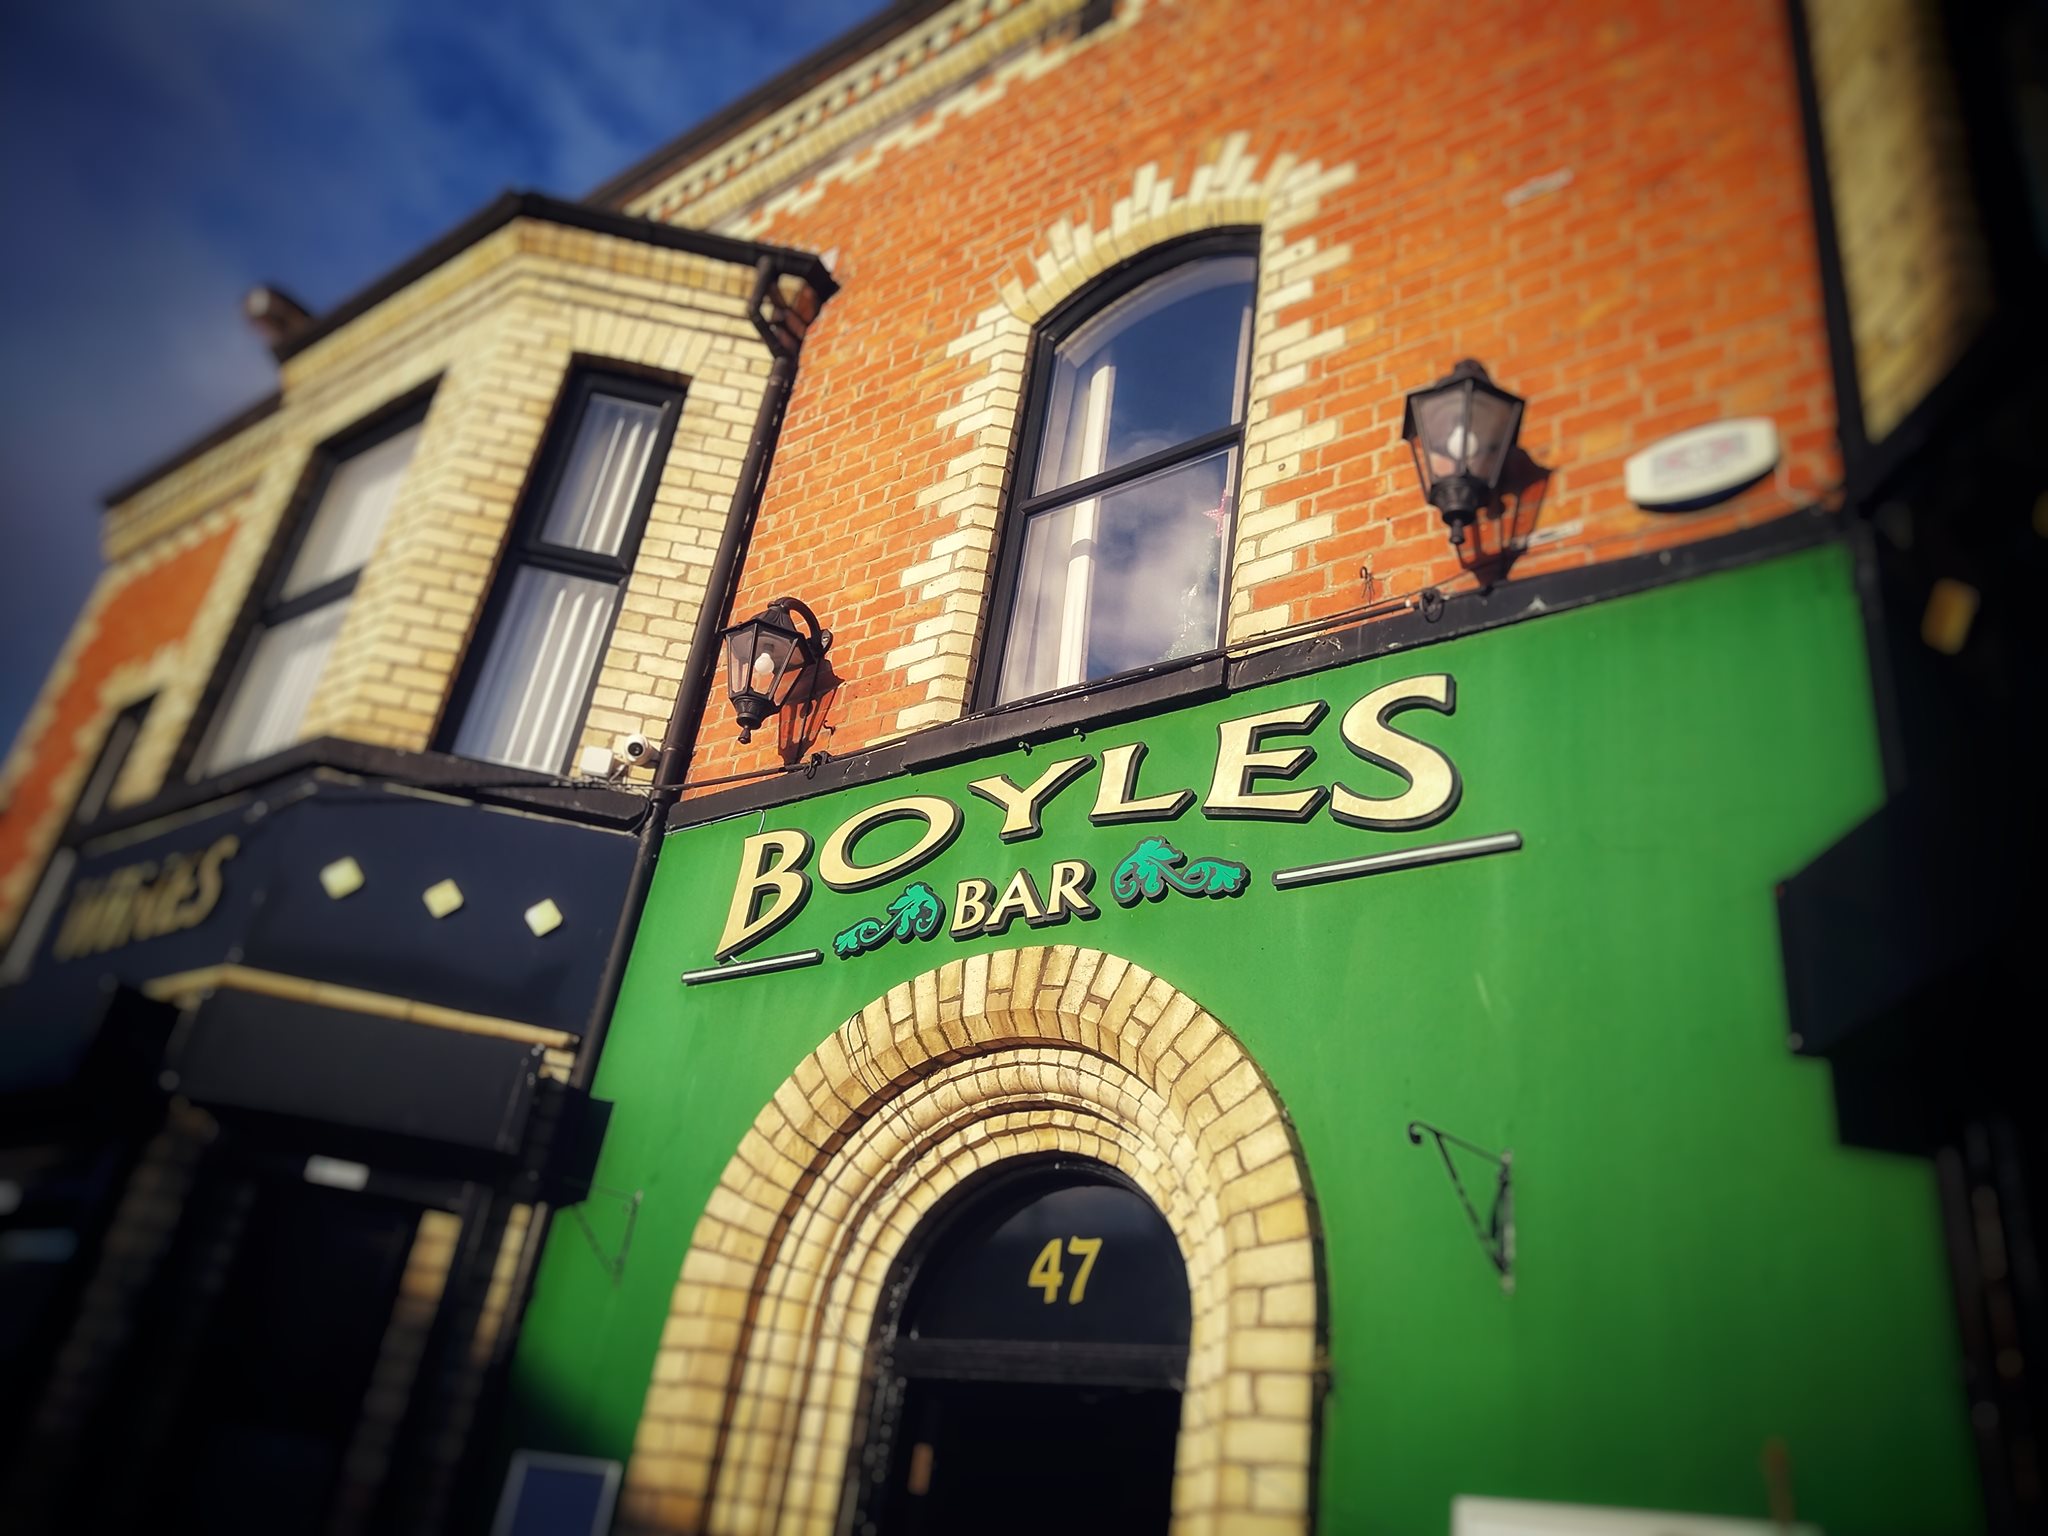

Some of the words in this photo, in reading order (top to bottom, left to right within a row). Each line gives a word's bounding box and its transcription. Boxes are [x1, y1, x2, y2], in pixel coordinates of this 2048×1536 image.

[713, 674, 1462, 963] BOYLES
[947, 858, 1101, 941] BAR
[1027, 1234, 1104, 1305] 47
